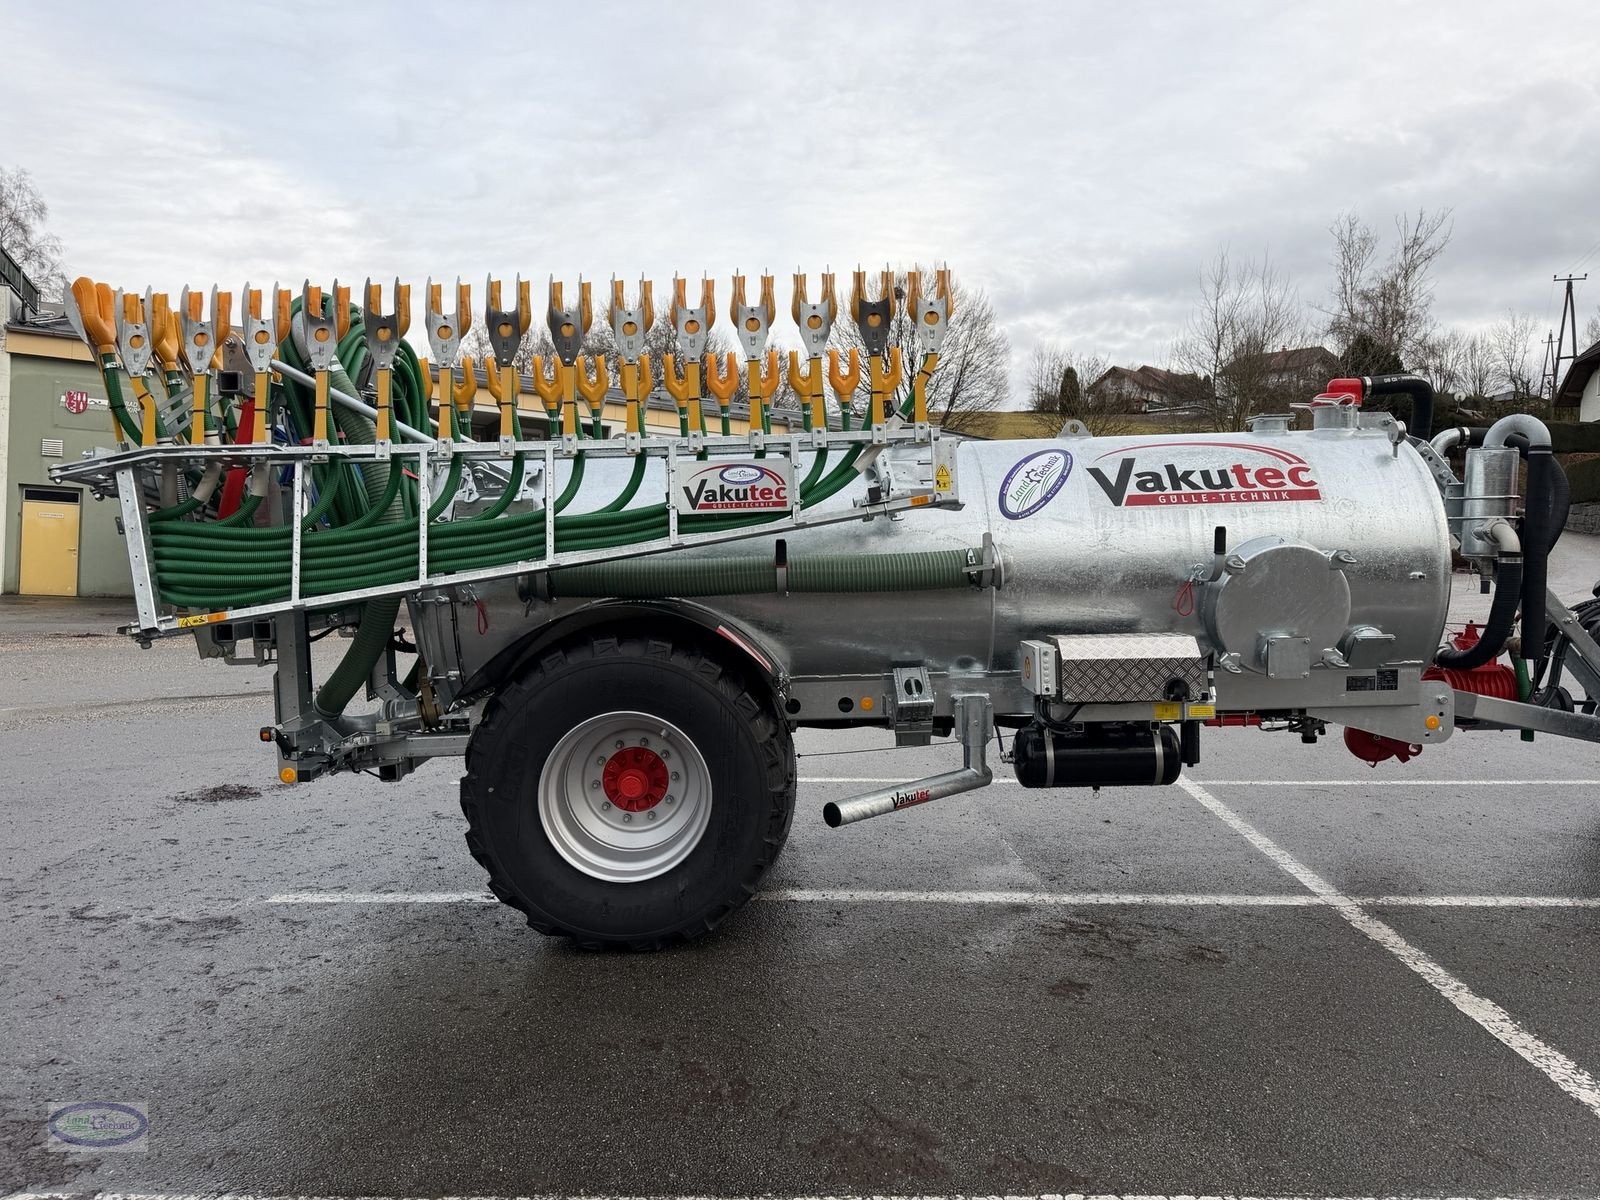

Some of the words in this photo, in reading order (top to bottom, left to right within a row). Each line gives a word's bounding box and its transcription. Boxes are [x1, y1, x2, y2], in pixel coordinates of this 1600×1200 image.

[682, 479, 787, 511] Vakutec
[1010, 479, 1031, 502] Land
[1033, 455, 1061, 479] Technik
[1086, 457, 1318, 507] Vakutec
[1158, 490, 1291, 504] GÜLLE-TECHNIK
